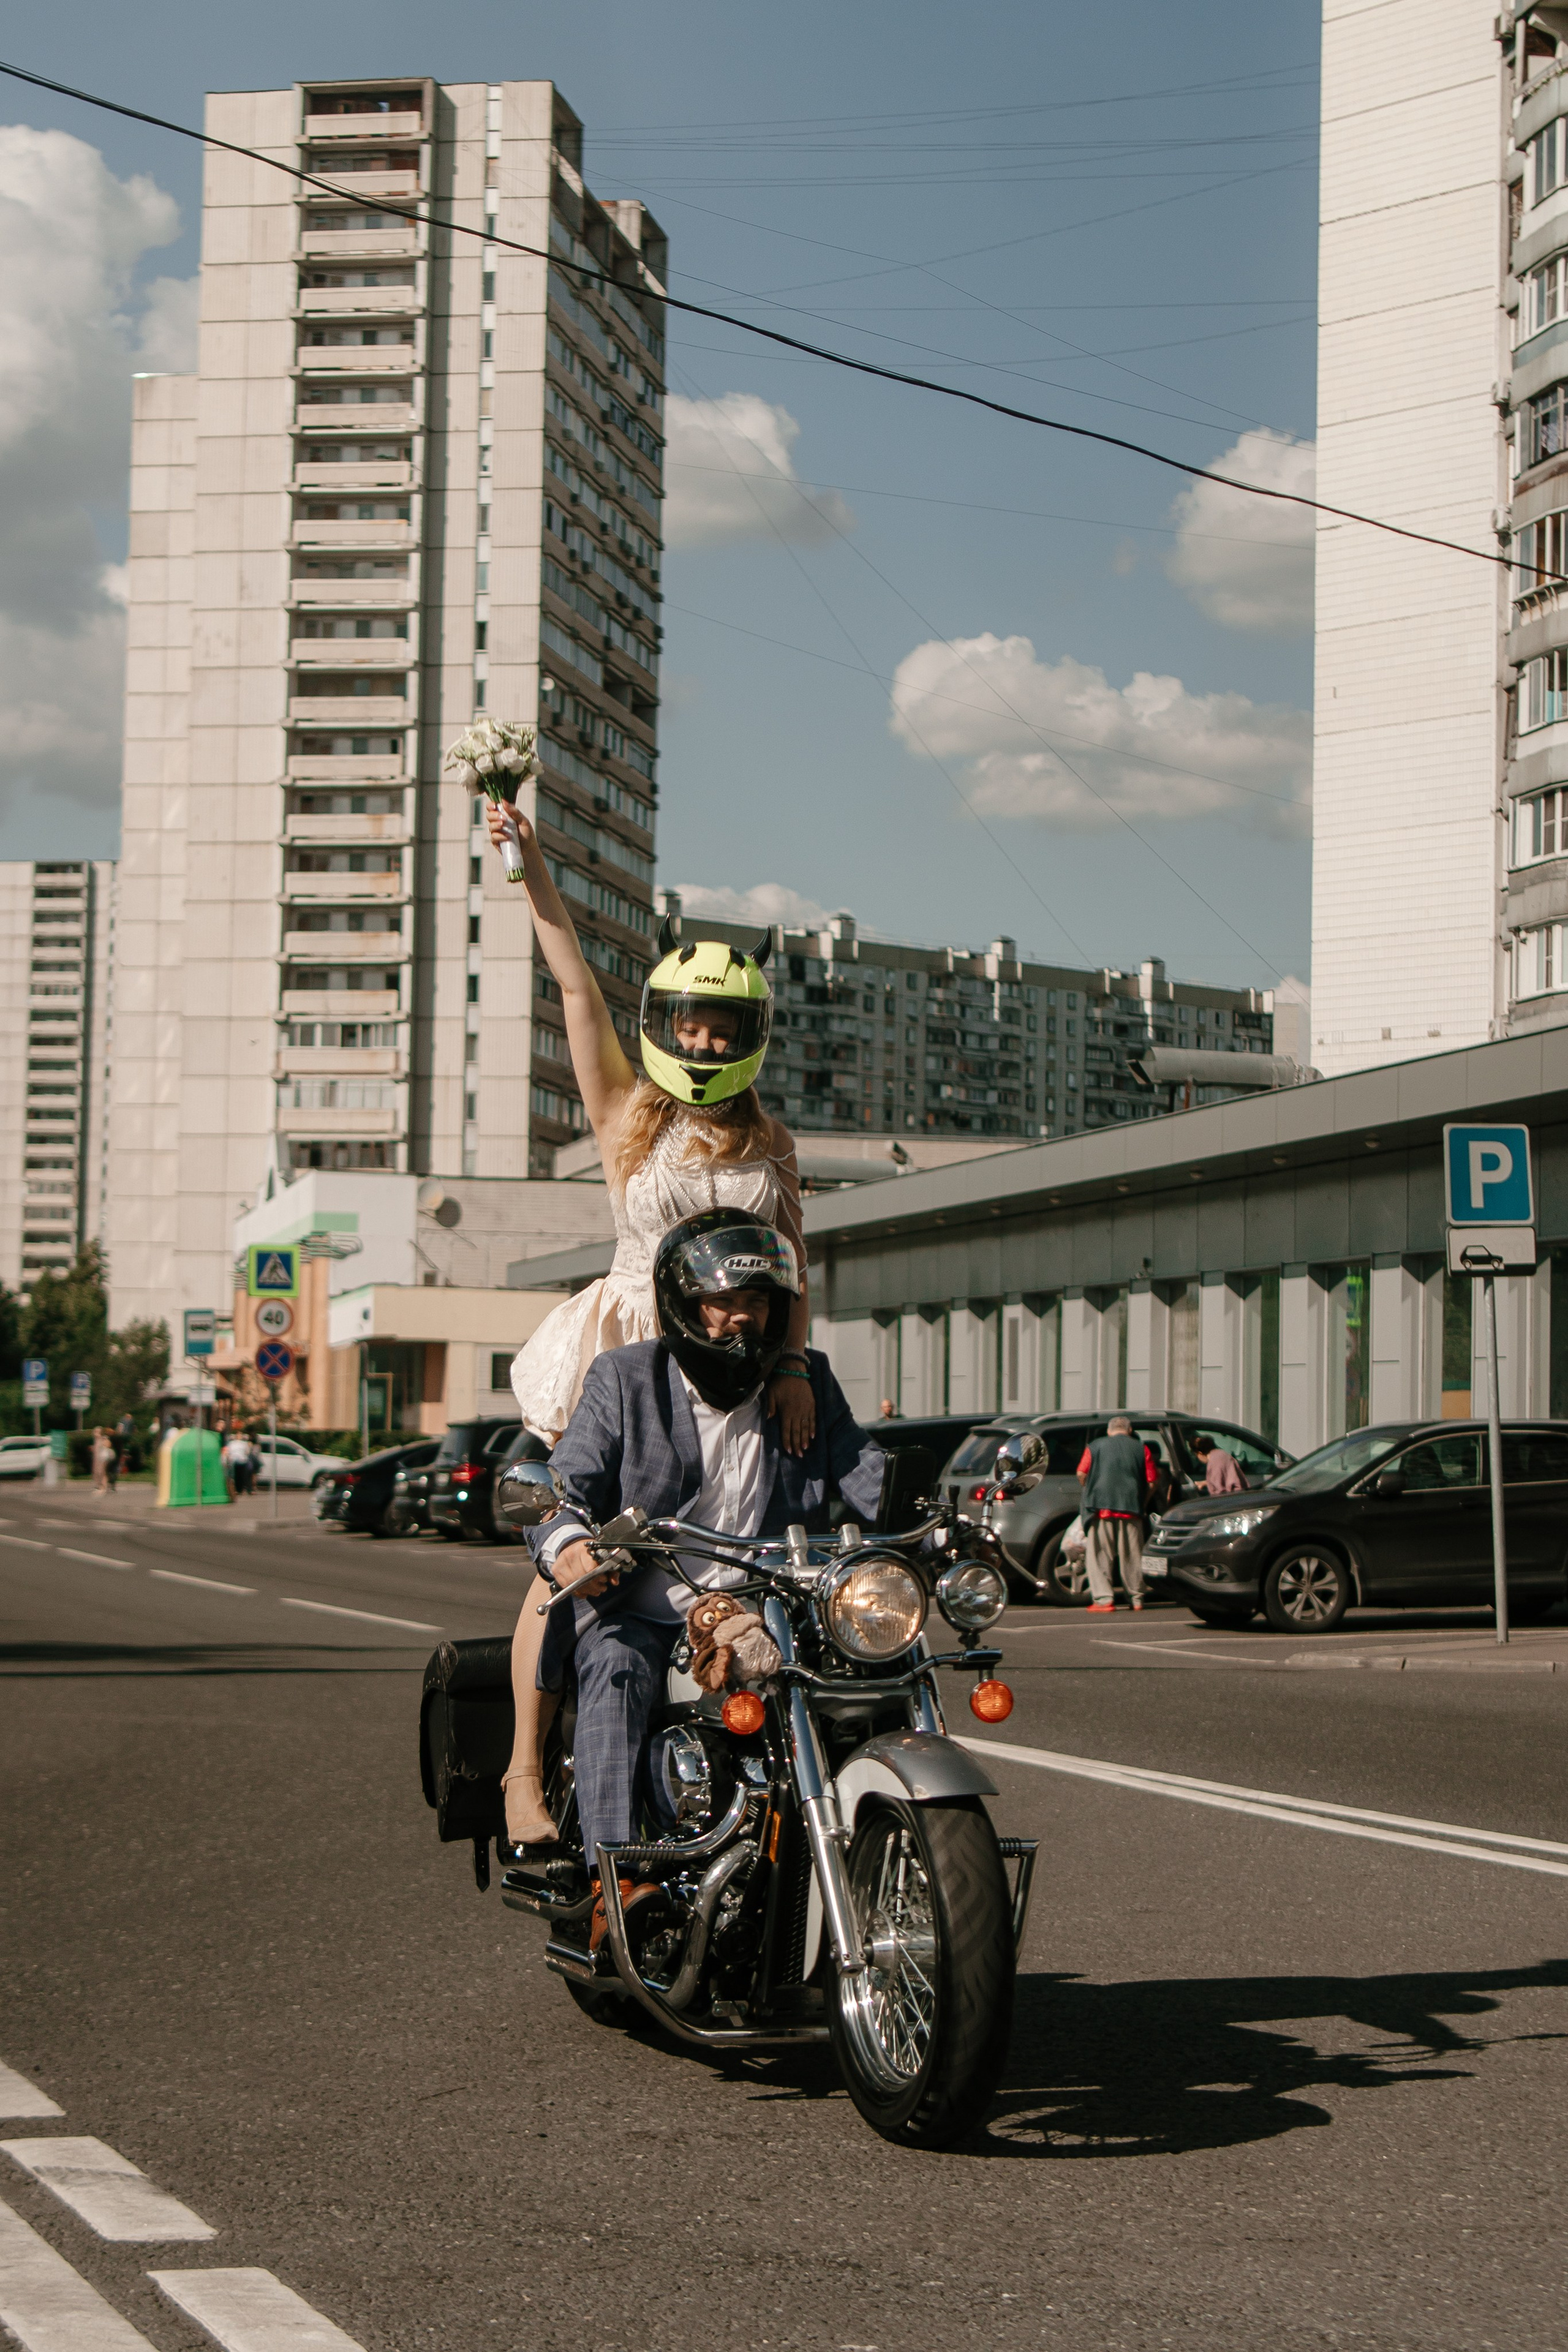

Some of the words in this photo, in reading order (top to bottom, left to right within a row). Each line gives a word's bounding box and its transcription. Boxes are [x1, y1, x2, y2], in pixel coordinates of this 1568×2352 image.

[693, 975, 725, 986] SMK
[1468, 1140, 1512, 1208] P
[728, 1259, 768, 1267] HJC
[263, 1310, 284, 1325] 40
[30, 1361, 44, 1378] P
